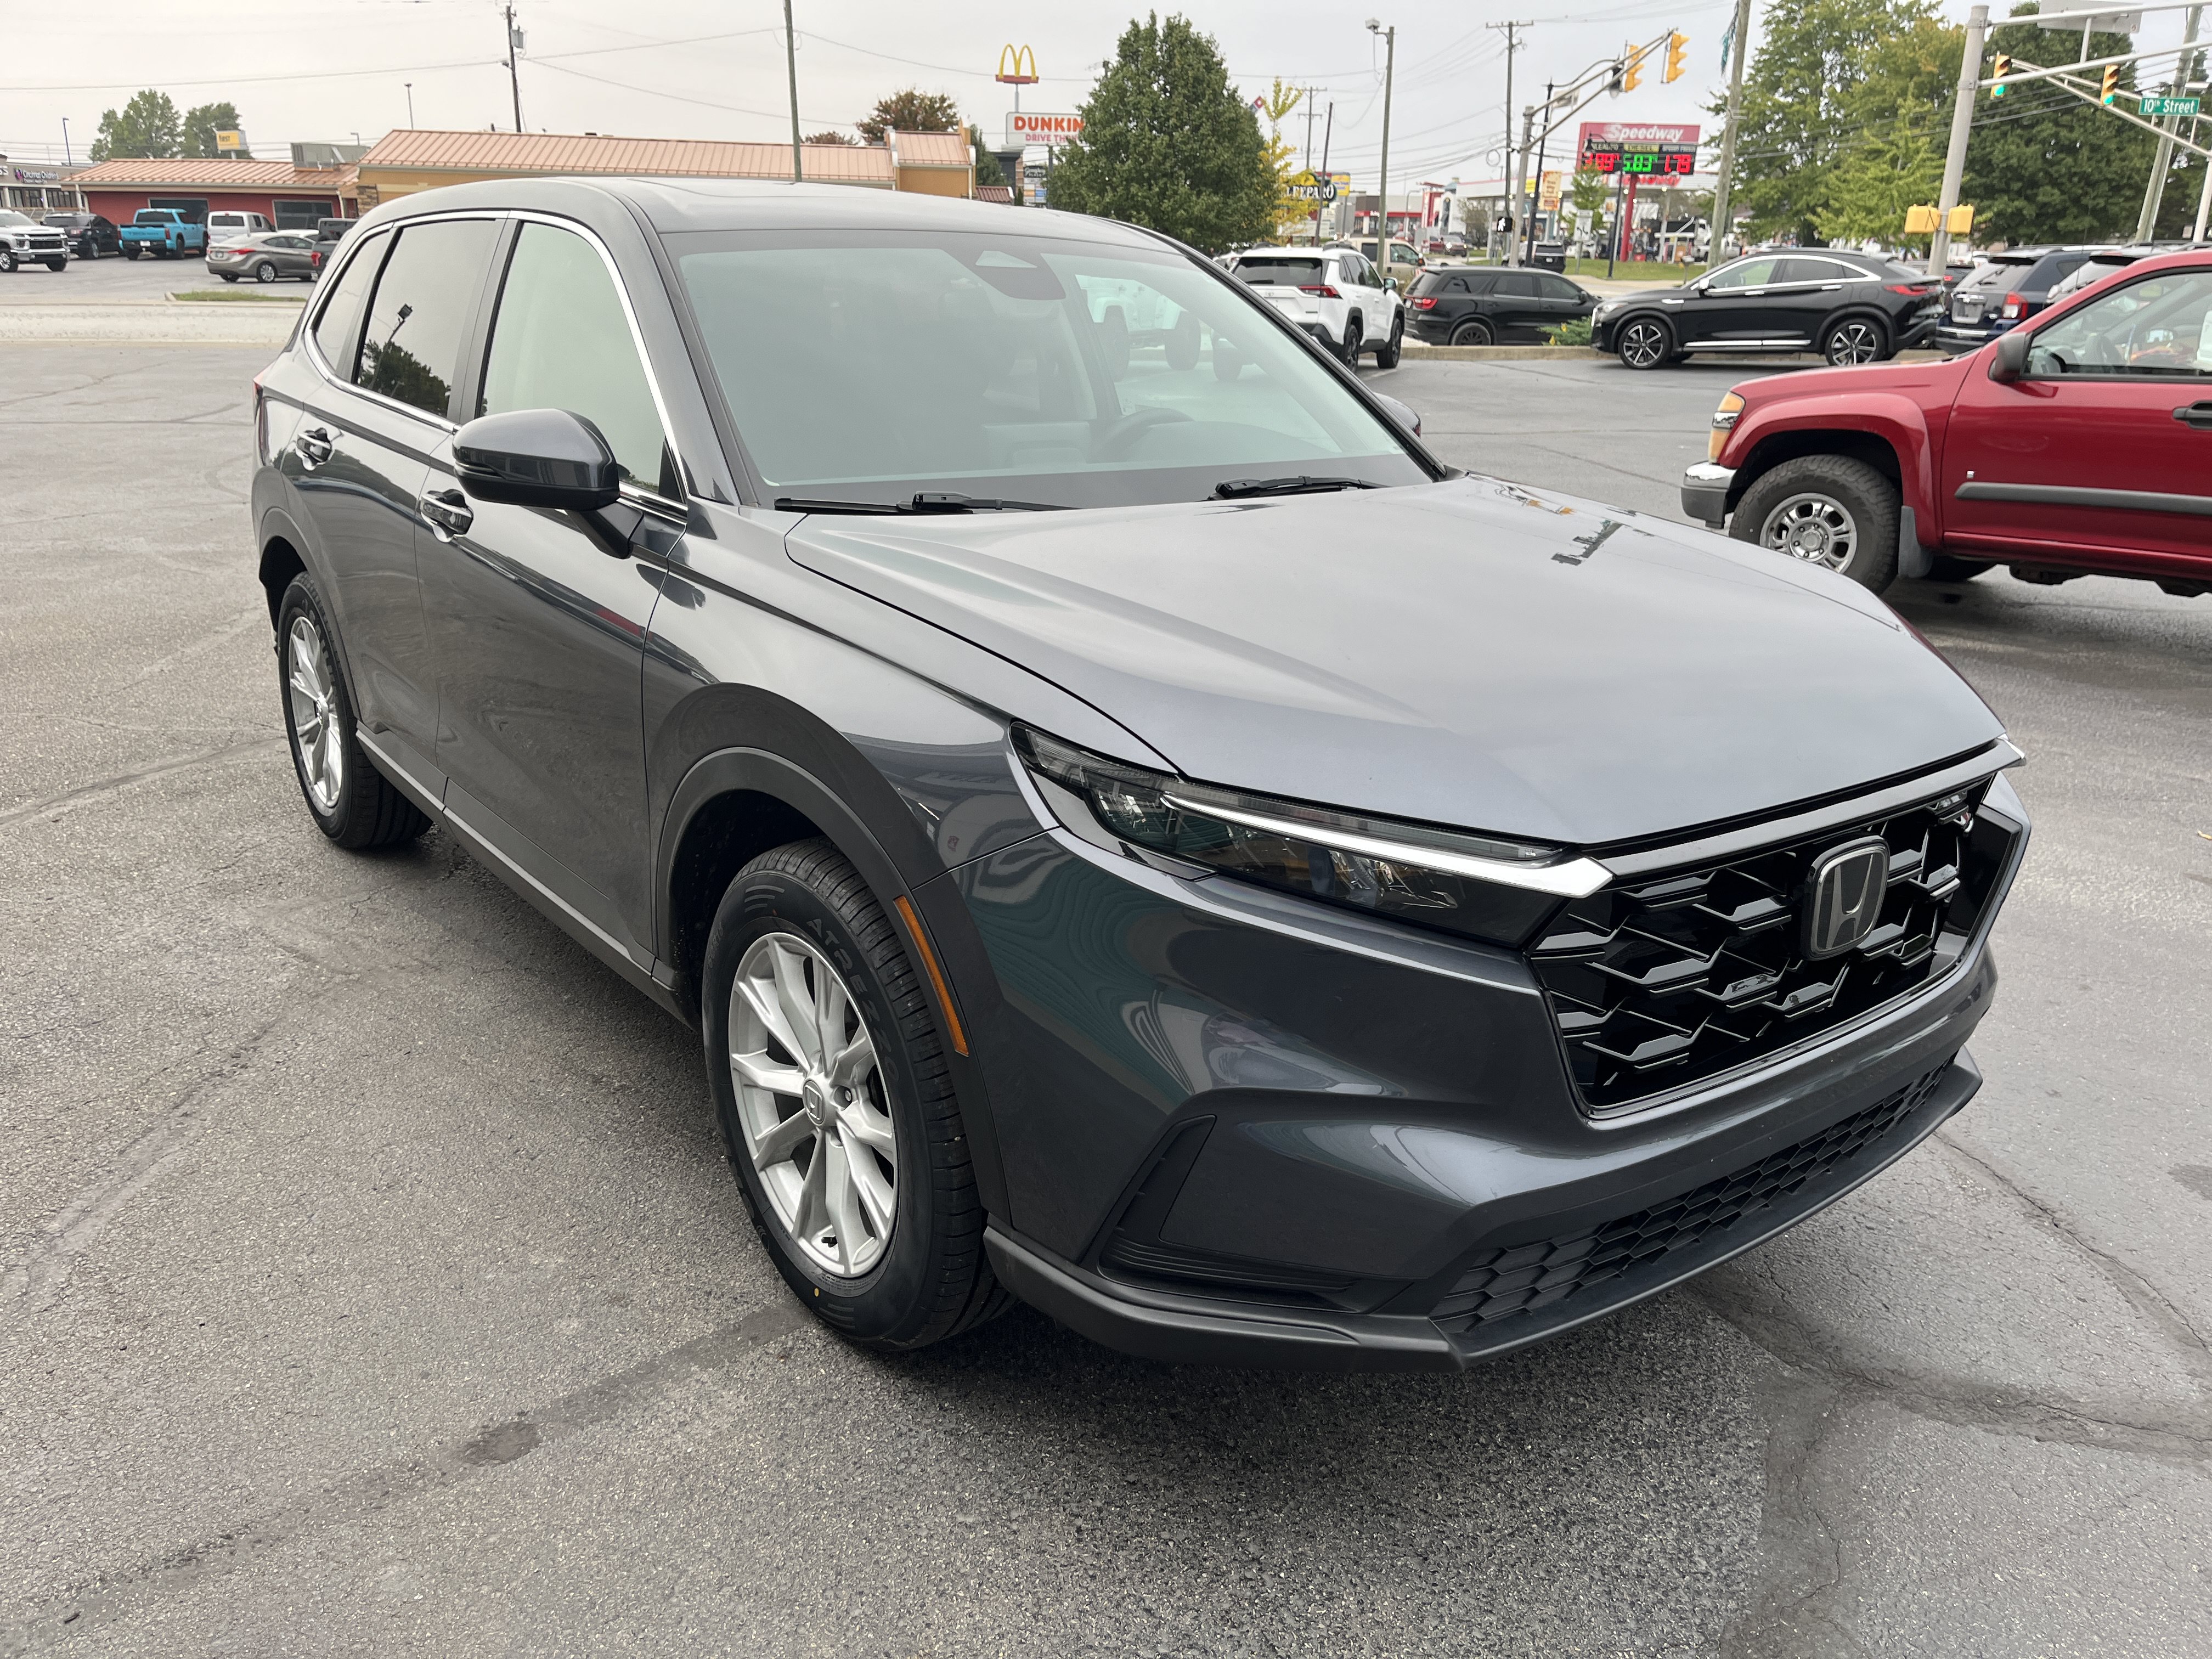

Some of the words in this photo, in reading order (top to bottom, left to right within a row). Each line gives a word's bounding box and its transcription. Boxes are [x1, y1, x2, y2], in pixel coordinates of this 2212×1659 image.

[2144, 99, 2160, 112] 10th
[2163, 99, 2195, 113] Street
[1014, 116, 1085, 132] DUNKIN
[1026, 133, 1051, 142] DRIVE
[1054, 134, 1078, 143] TH
[1606, 124, 1684, 142] Speedway
[806, 918, 899, 1081] ATREZZO
